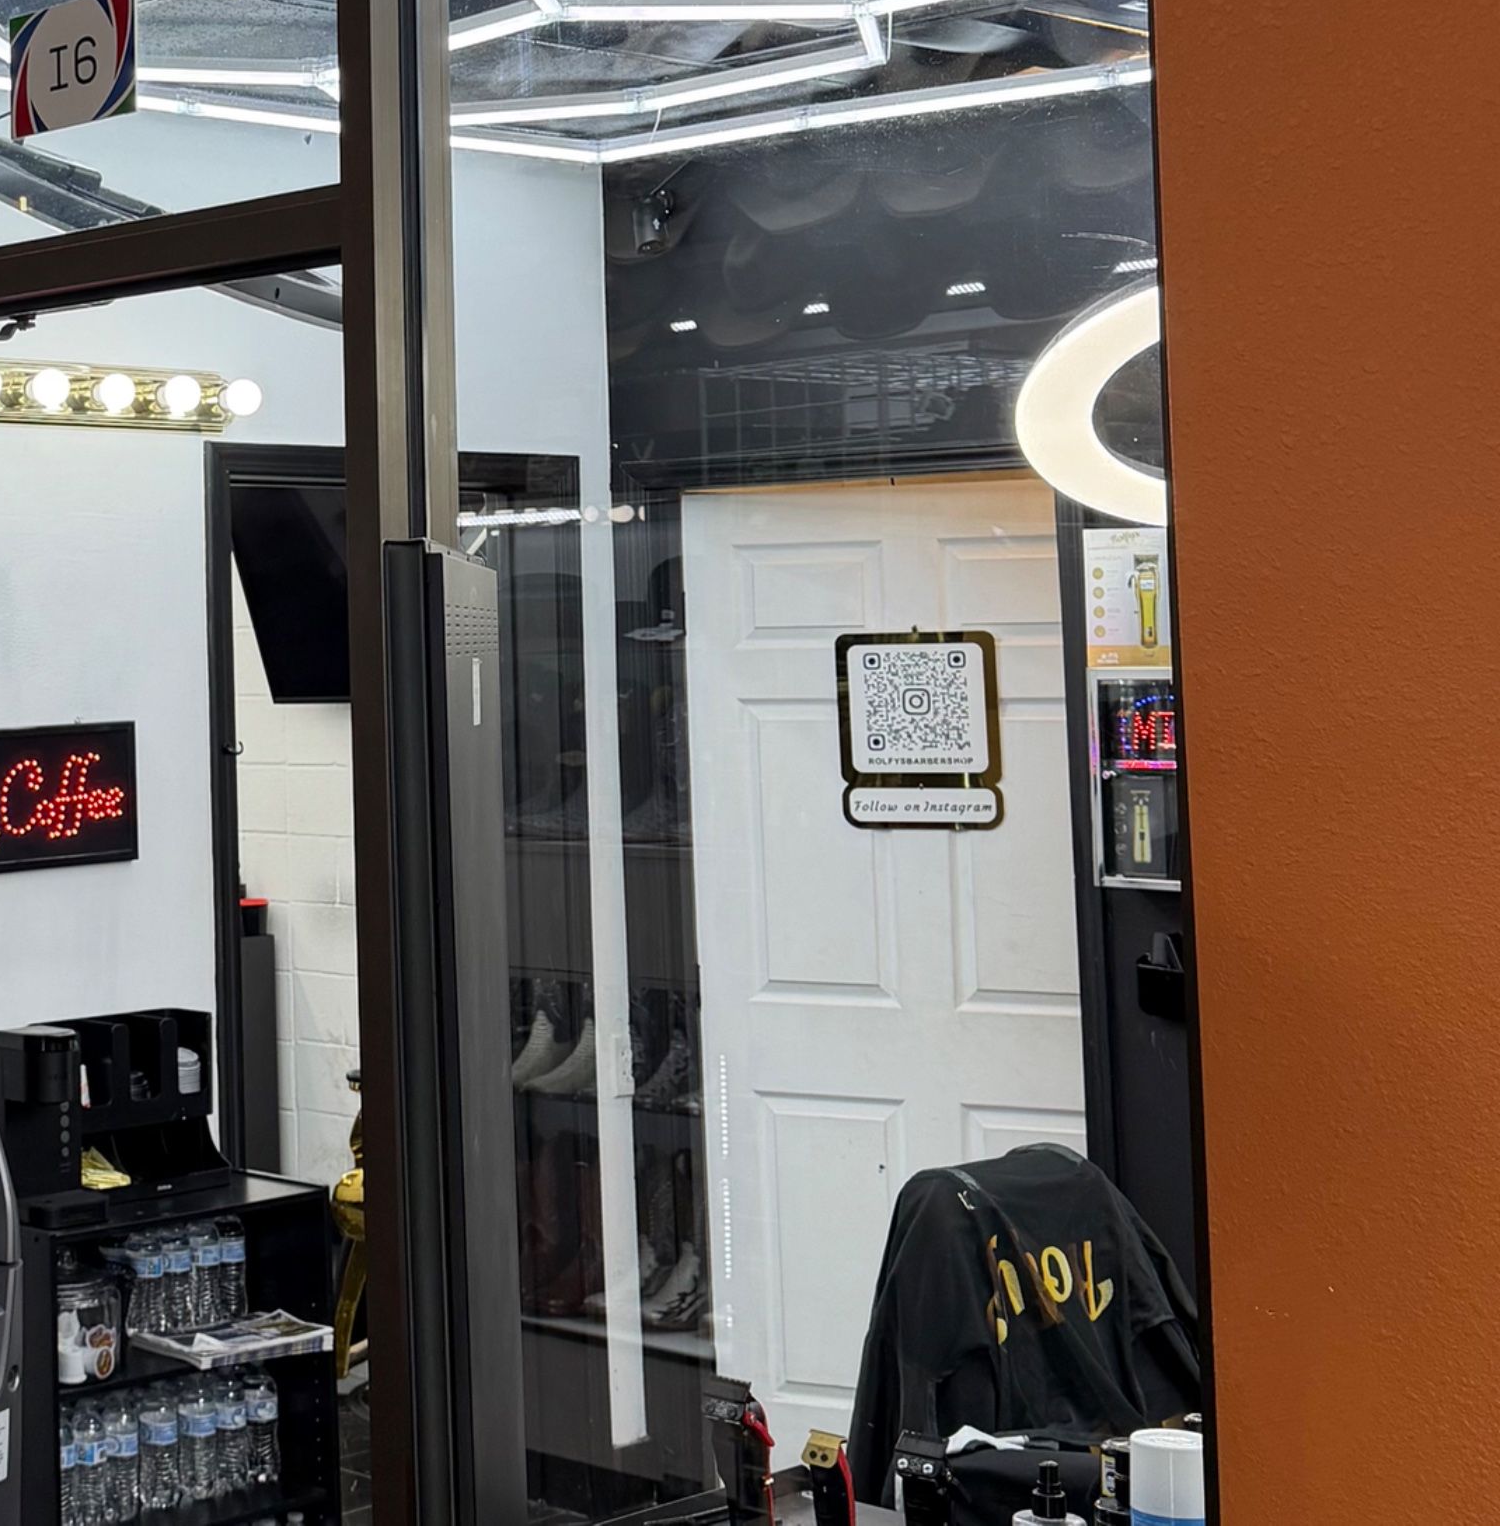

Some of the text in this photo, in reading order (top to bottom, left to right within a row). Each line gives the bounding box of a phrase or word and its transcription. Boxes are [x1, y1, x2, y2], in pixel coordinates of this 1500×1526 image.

[867, 756, 975, 766] ROLFYSBARBERSHOP
[1, 751, 124, 839] Coffee
[854, 800, 993, 815] Follow on Instagram
